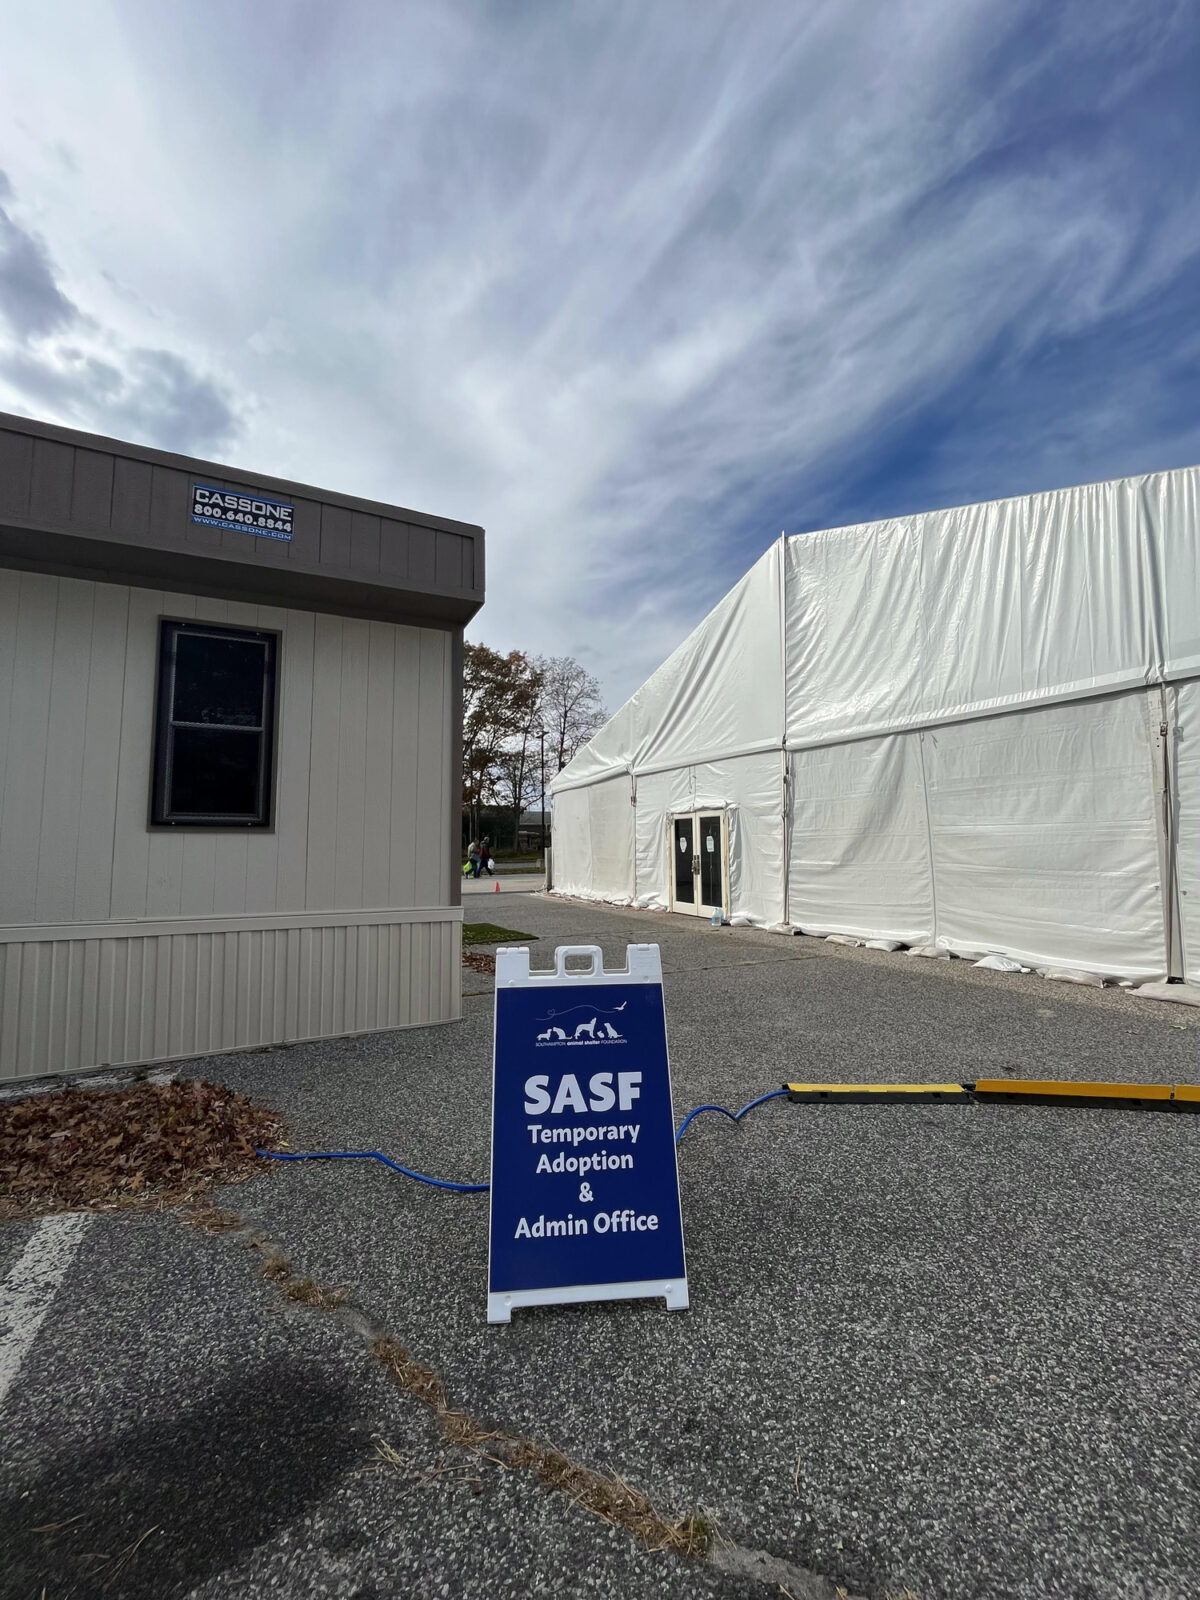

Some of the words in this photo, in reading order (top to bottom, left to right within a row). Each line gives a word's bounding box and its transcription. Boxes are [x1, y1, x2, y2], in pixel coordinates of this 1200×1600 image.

[194, 503, 292, 532] 800.640.8844
[195, 489, 292, 521] CASSONE
[193, 516, 292, 541] WWW.CASSONE.COM
[524, 1071, 643, 1116] SASF
[527, 1123, 641, 1147] Temporary
[536, 1150, 634, 1177] Adoption
[578, 1182, 594, 1203] &
[514, 1214, 588, 1239] Admin
[593, 1209, 659, 1234] Office
